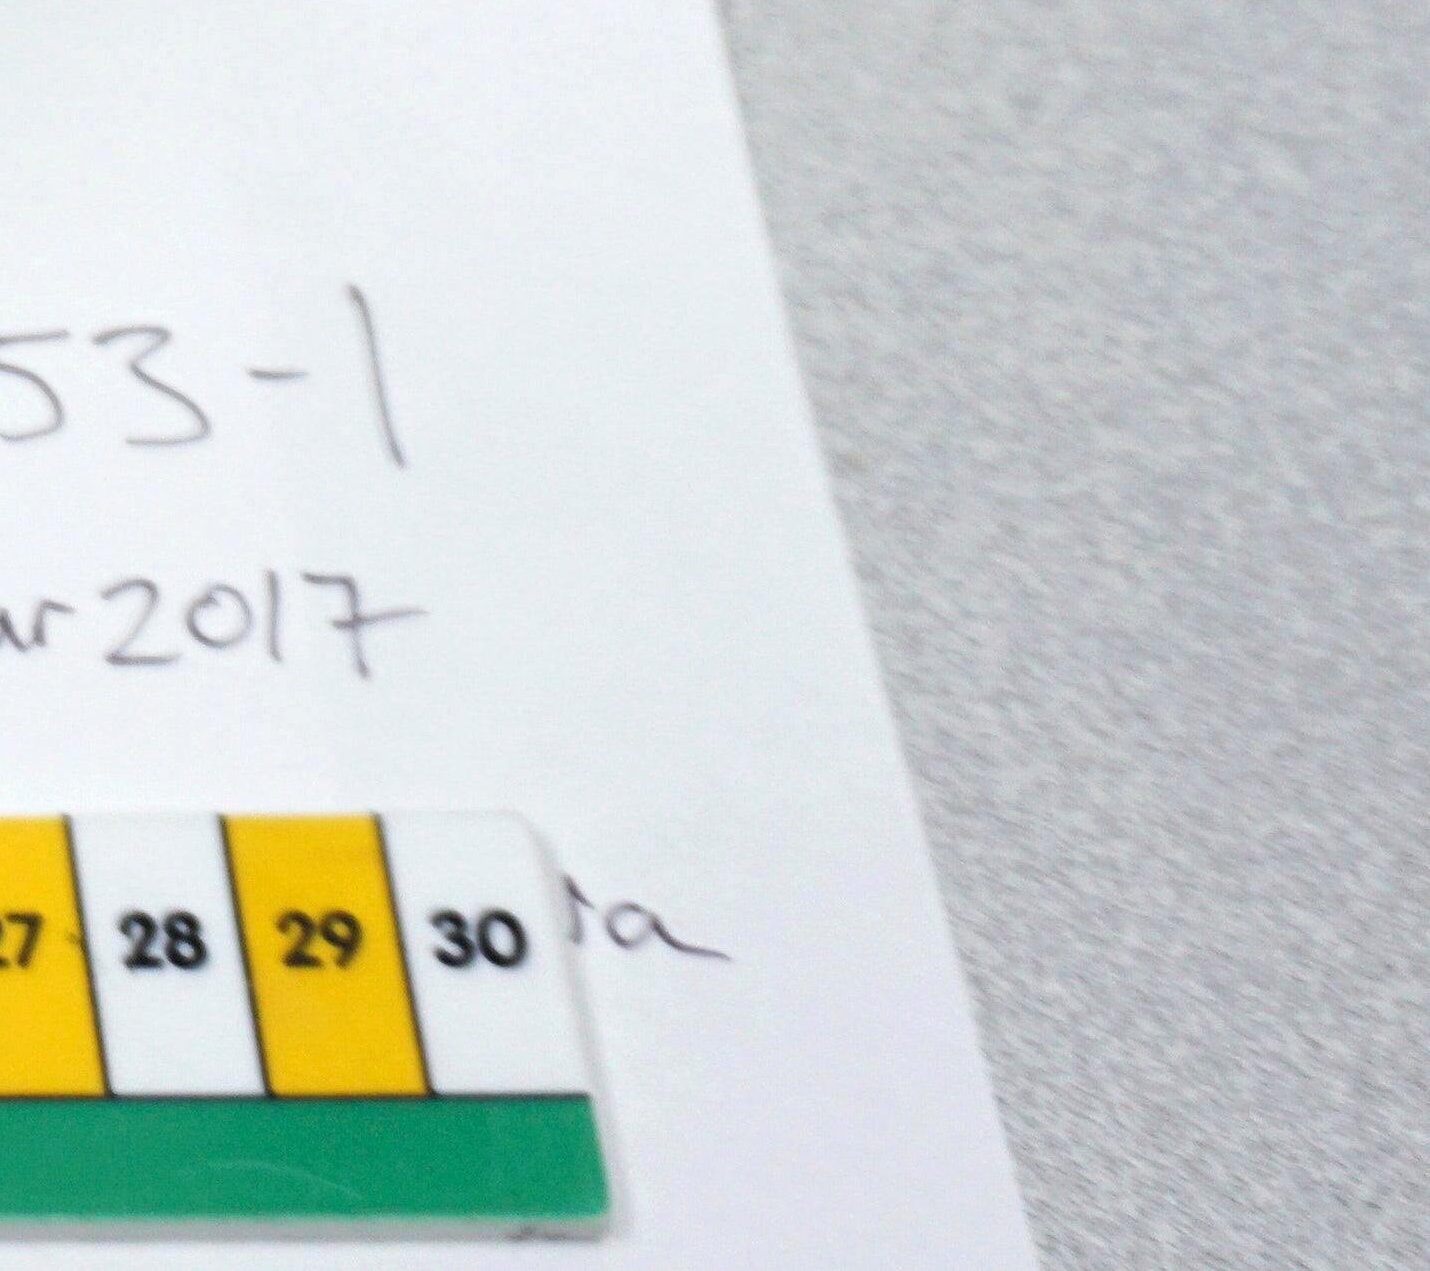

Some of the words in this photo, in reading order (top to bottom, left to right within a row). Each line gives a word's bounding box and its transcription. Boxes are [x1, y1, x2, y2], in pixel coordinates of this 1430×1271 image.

[100, 567, 430, 679] 2017
[119, 911, 208, 971] 28
[278, 910, 363, 969] 29
[431, 909, 528, 969] 30
